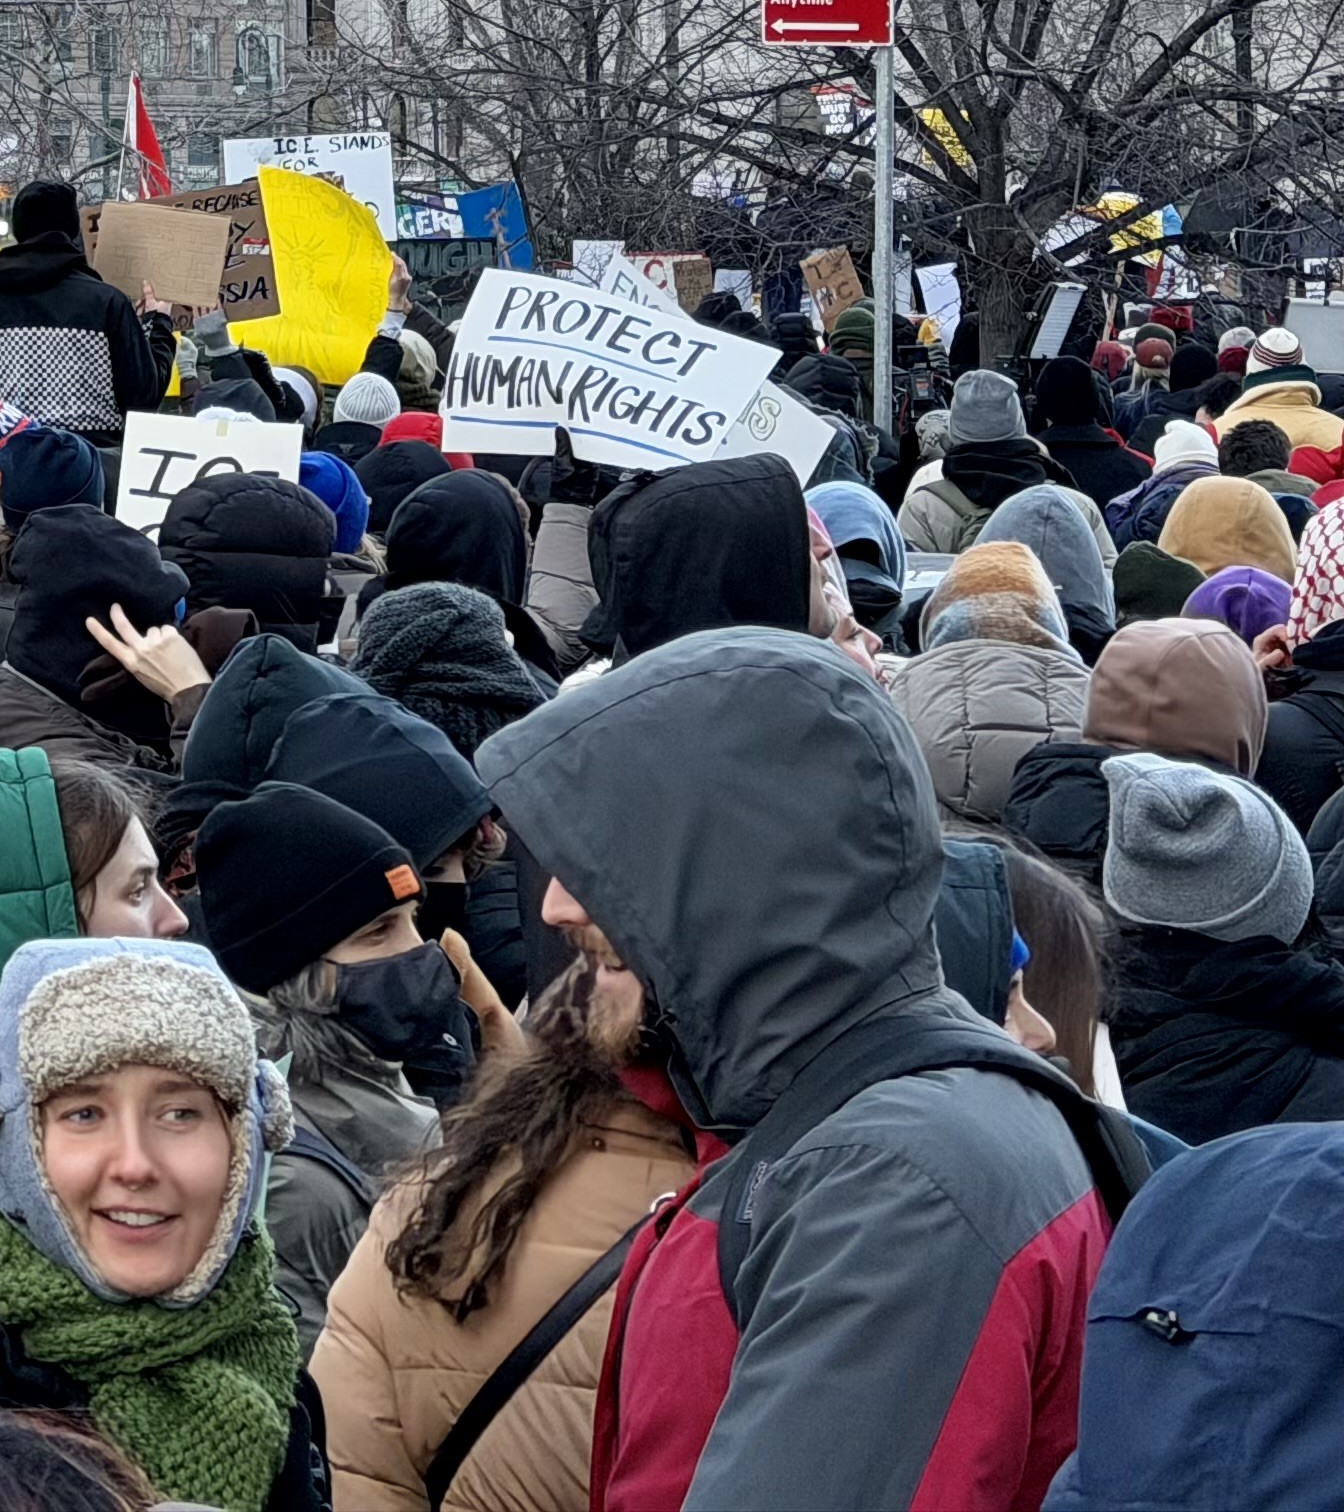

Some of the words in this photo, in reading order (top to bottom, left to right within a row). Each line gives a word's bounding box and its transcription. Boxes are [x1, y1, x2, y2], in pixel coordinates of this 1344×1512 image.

[329, 135, 391, 153] STANDS
[495, 286, 717, 377] PROTECT
[446, 352, 573, 410] HUMAN
[568, 364, 727, 446] RIGHTS
